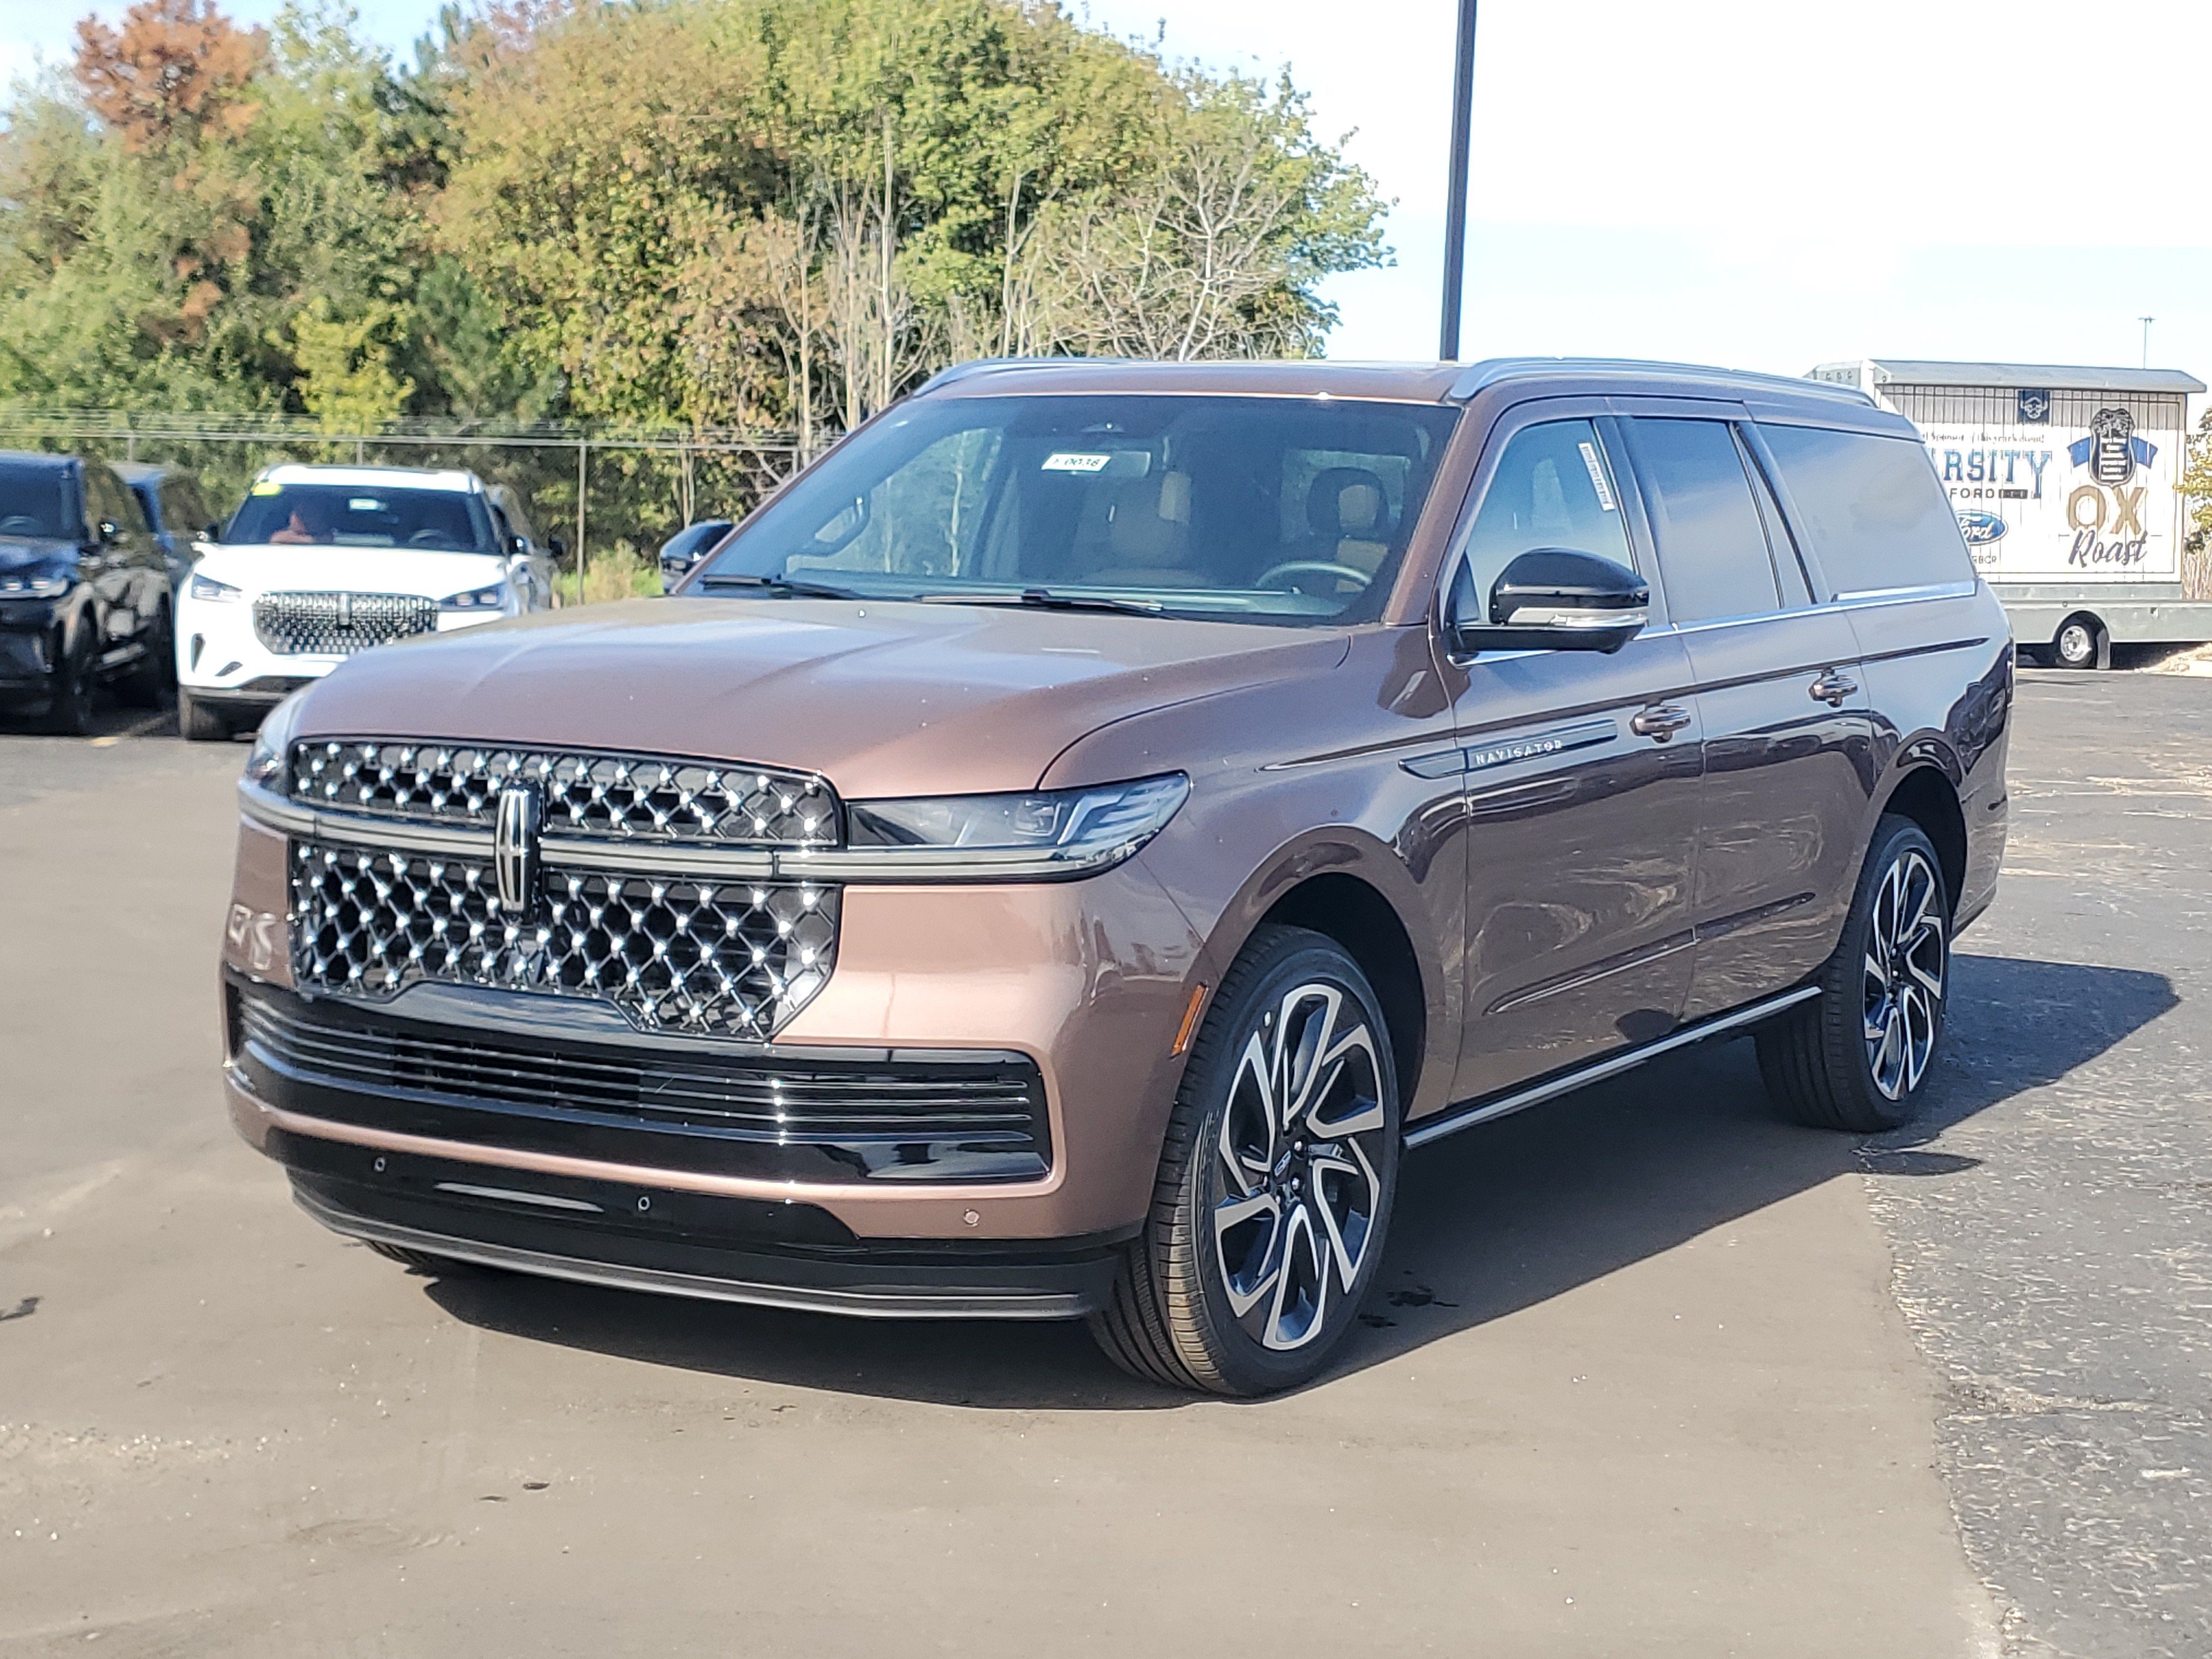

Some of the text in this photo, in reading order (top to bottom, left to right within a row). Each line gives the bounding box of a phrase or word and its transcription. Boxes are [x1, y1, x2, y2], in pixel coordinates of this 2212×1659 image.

[1927, 448, 2052, 499] RSITY
[1950, 488, 1995, 499] FORD
[2067, 484, 2148, 535] OX
[2068, 529, 2148, 568] Roast
[1476, 740, 1562, 765] NAVIGATOR
